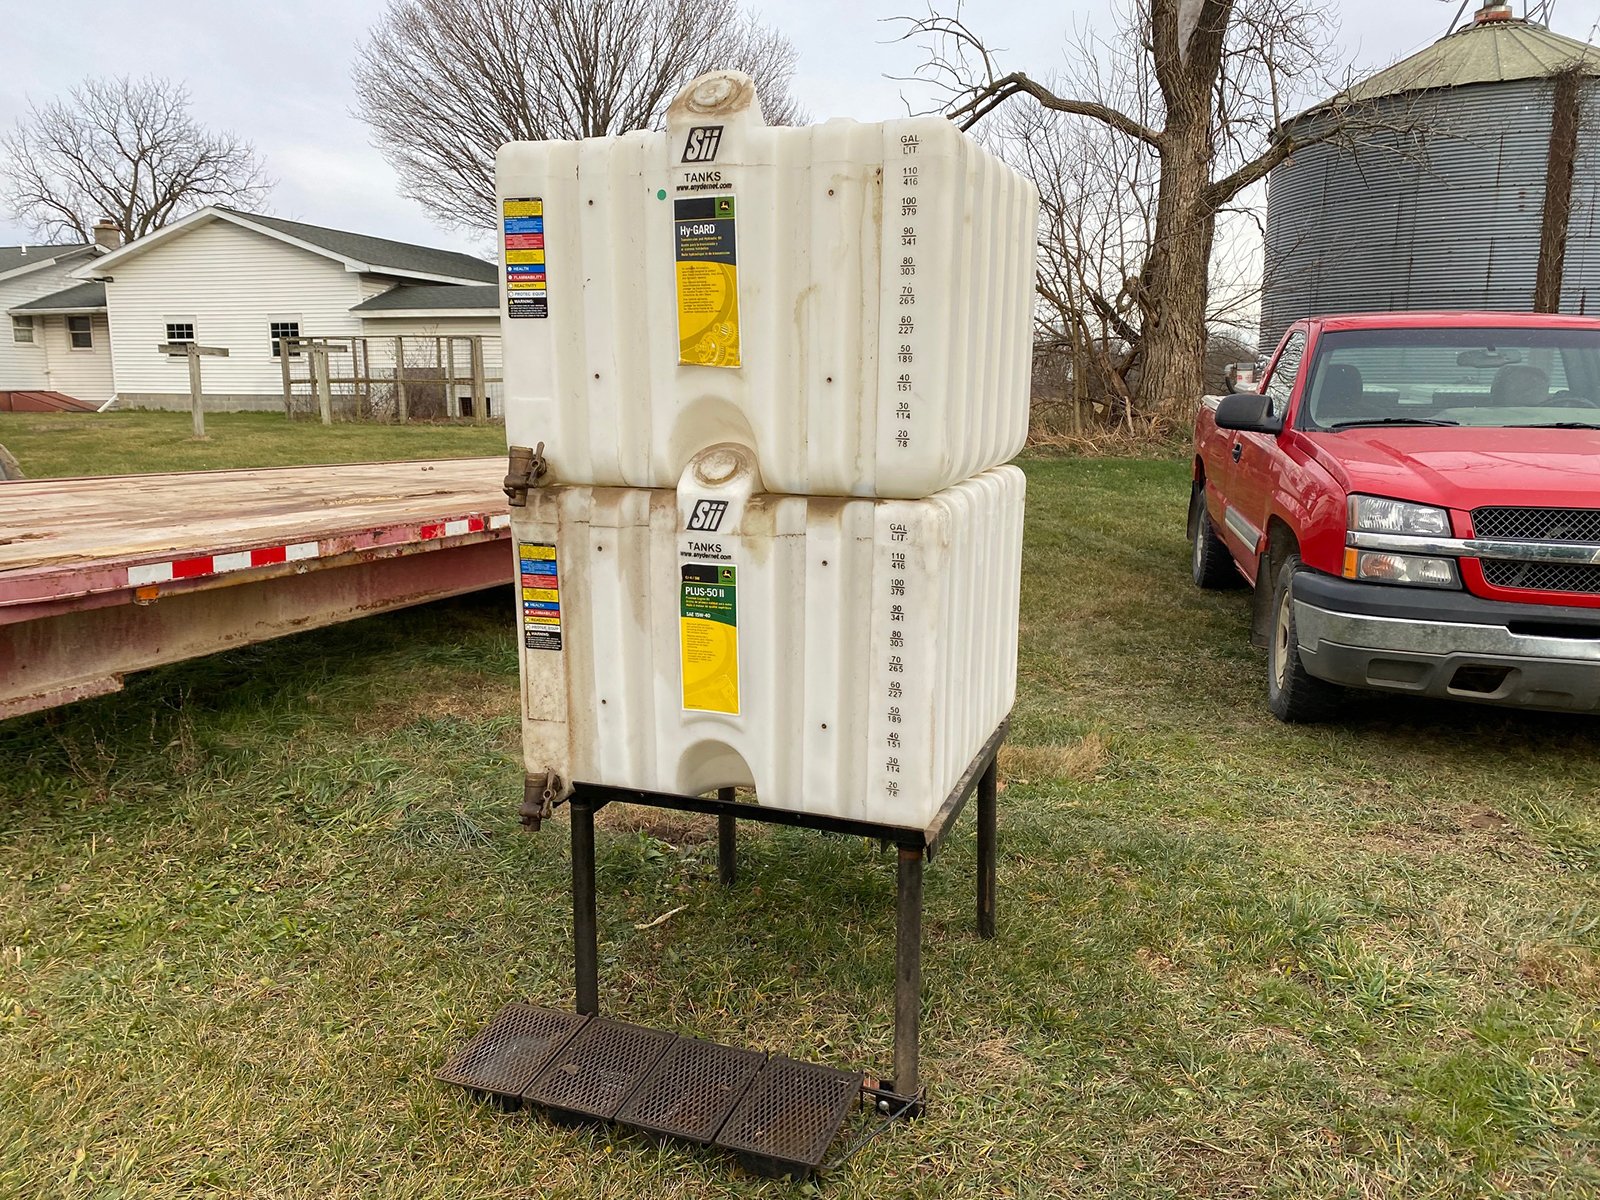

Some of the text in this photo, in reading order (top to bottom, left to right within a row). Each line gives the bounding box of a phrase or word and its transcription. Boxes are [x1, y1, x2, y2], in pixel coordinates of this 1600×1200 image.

[684, 171, 722, 182] TANKS
[902, 208, 916, 216] 379
[680, 224, 716, 237] Hy-GARD
[902, 256, 913, 264] 80
[689, 500, 727, 531] Sii
[688, 542, 722, 552] TANKS
[685, 586, 718, 597] PLUS-50
